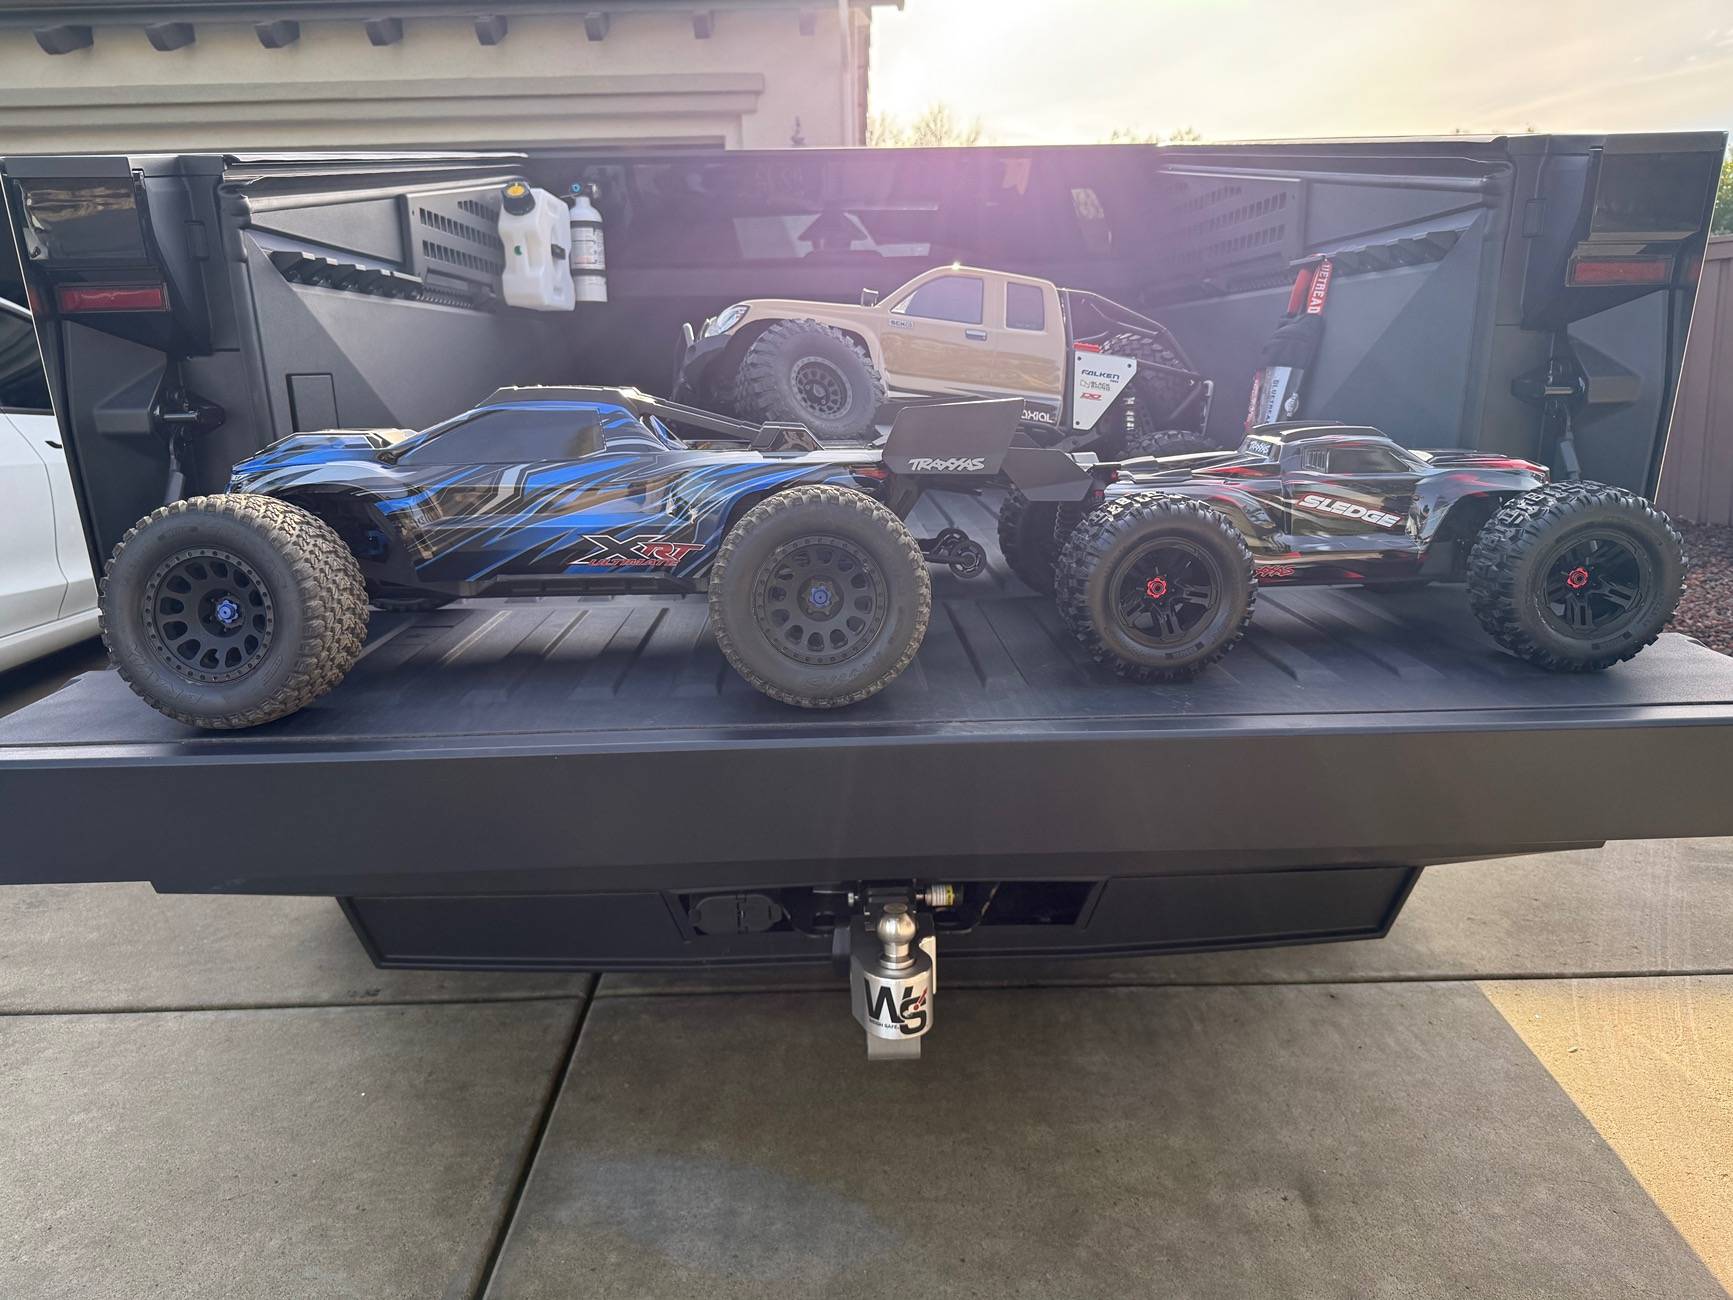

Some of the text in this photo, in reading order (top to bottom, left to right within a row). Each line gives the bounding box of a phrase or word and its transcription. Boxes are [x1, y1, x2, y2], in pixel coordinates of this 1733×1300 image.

[1081, 369, 1120, 379] FALKEN
[908, 457, 985, 472] TRAXXAS
[1299, 494, 1401, 529] SLEDGE
[569, 534, 706, 565] XRT
[588, 558, 680, 567] ULTIMATE
